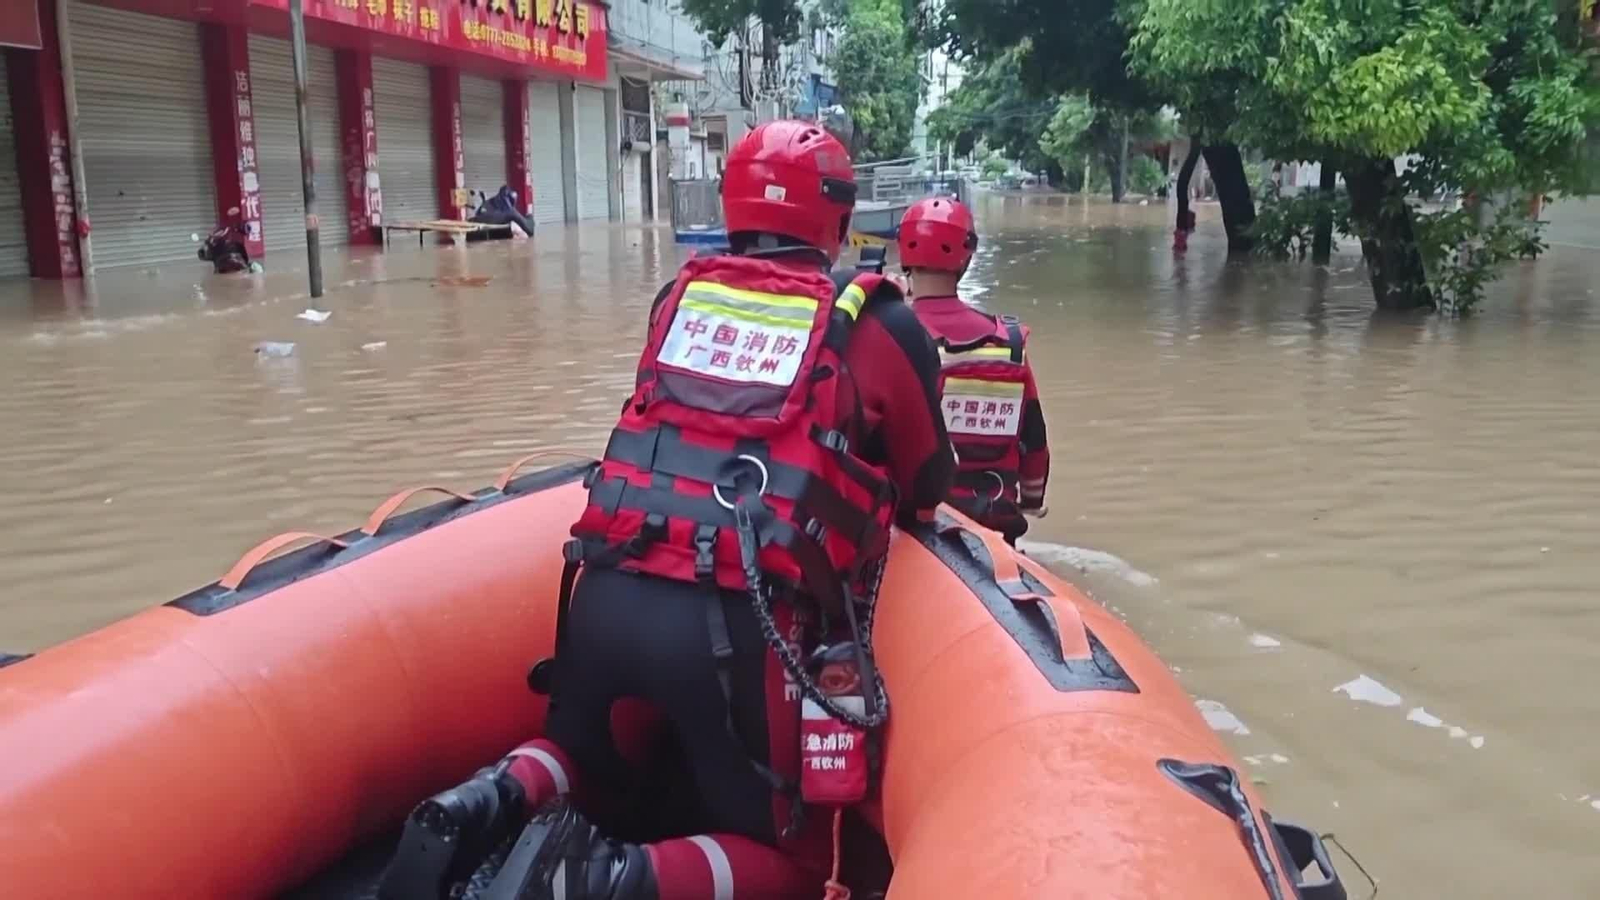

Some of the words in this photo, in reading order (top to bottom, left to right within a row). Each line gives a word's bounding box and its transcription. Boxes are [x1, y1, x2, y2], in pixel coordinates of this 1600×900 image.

[683, 319, 800, 356] 中国消防
[684, 345, 780, 375] 广西钦州
[946, 400, 1014, 415] 中国消防
[950, 416, 1006, 429] 广西钦州
